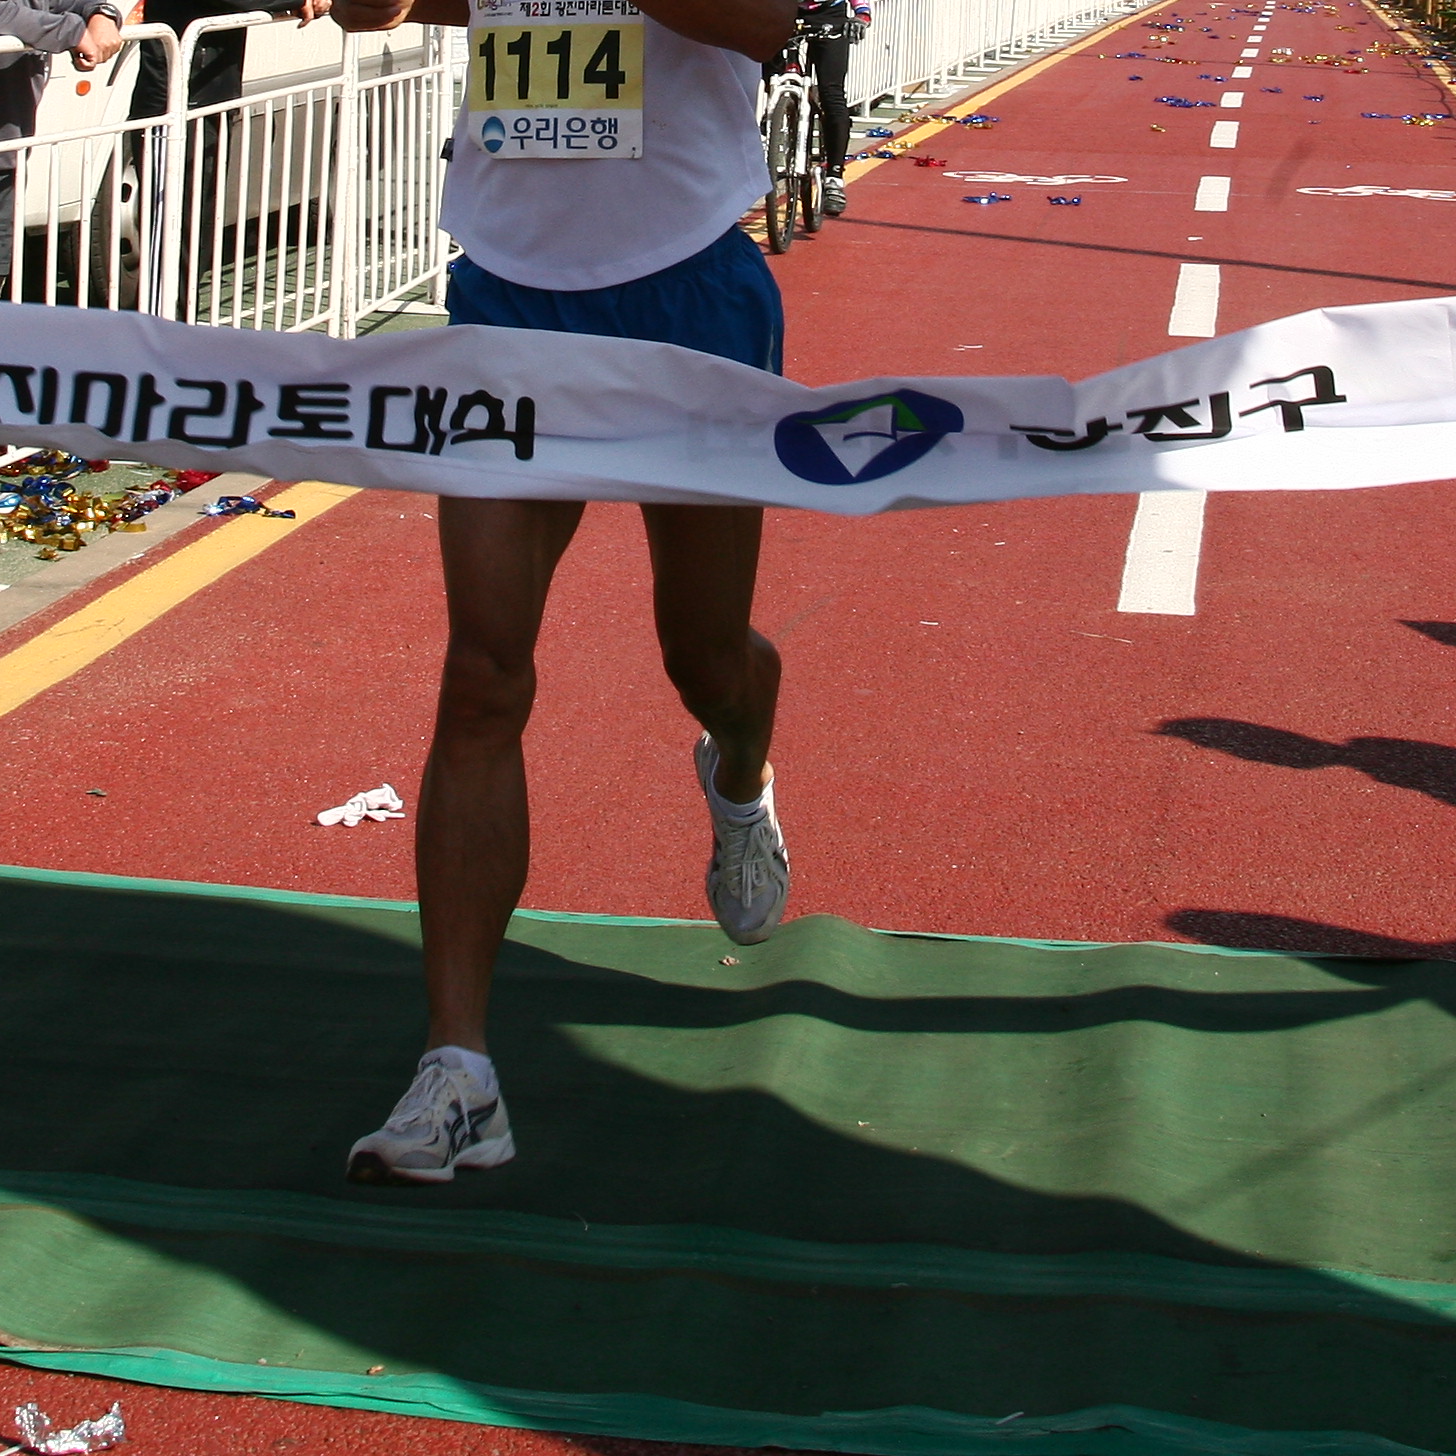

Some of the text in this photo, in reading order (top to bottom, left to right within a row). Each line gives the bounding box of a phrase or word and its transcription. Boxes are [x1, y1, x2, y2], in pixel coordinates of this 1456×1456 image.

[519, 0, 552, 18] 제2회
[479, 30, 626, 101] 1114
[510, 117, 619, 150] 우리은행
